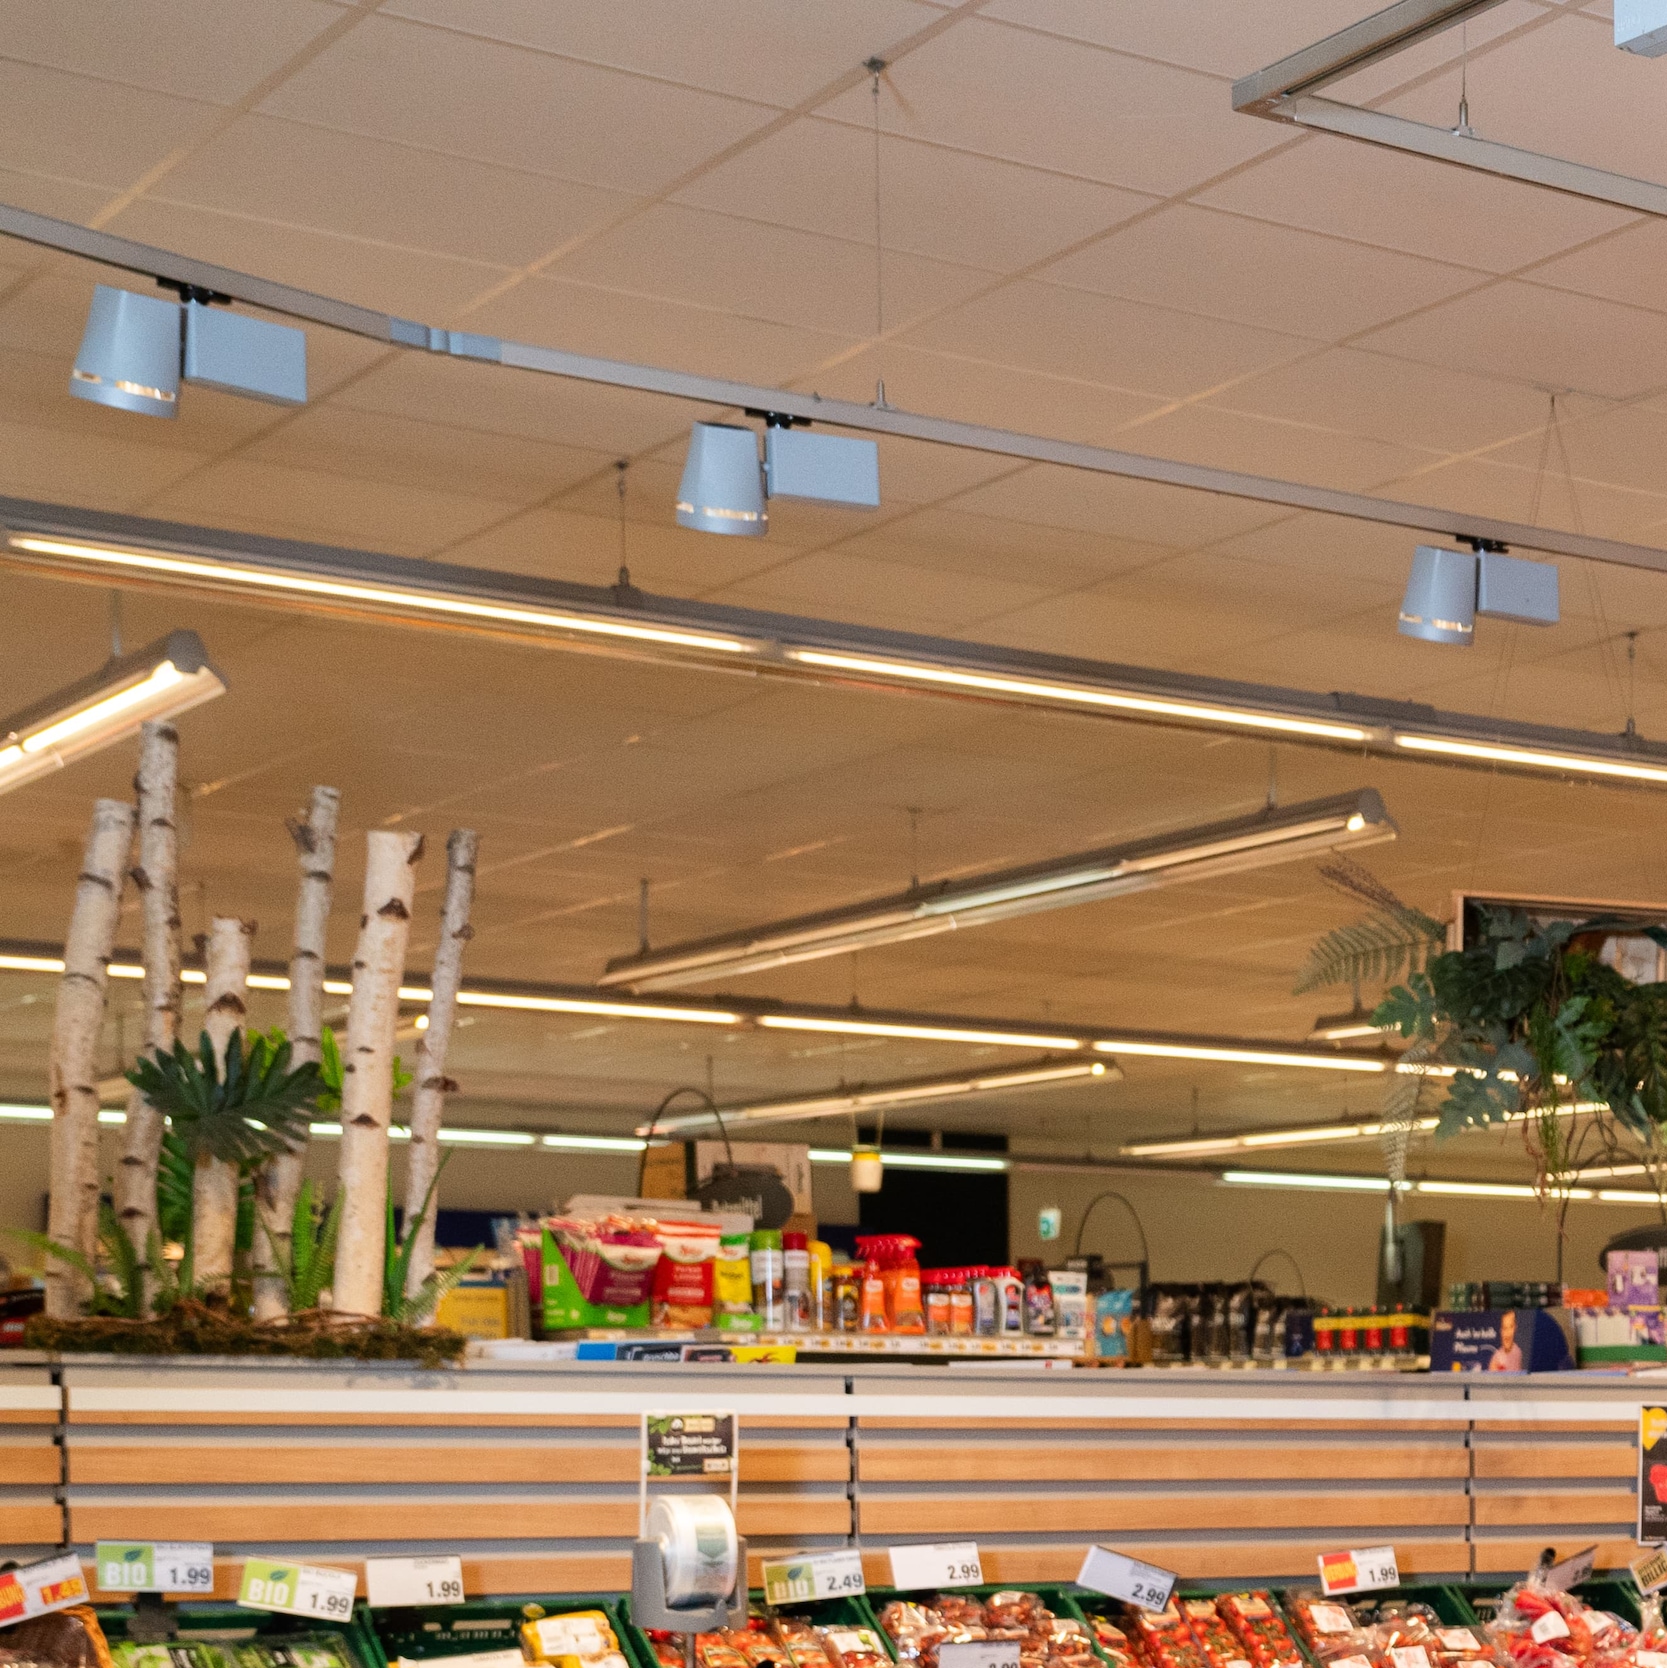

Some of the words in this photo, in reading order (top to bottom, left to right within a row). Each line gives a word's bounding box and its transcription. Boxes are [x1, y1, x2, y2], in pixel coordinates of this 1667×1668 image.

[105, 1563, 147, 1586] BIO
[170, 1566, 210, 1585] 1.99
[947, 1564, 980, 1580] 2.99
[1368, 1568, 1397, 1583] 1.99
[425, 1581, 461, 1598] 1.99
[826, 1574, 863, 1591] 2.49
[249, 1580, 290, 1607] BIO
[1131, 1583, 1166, 1606] 2.99
[309, 1592, 350, 1615] 1.99
